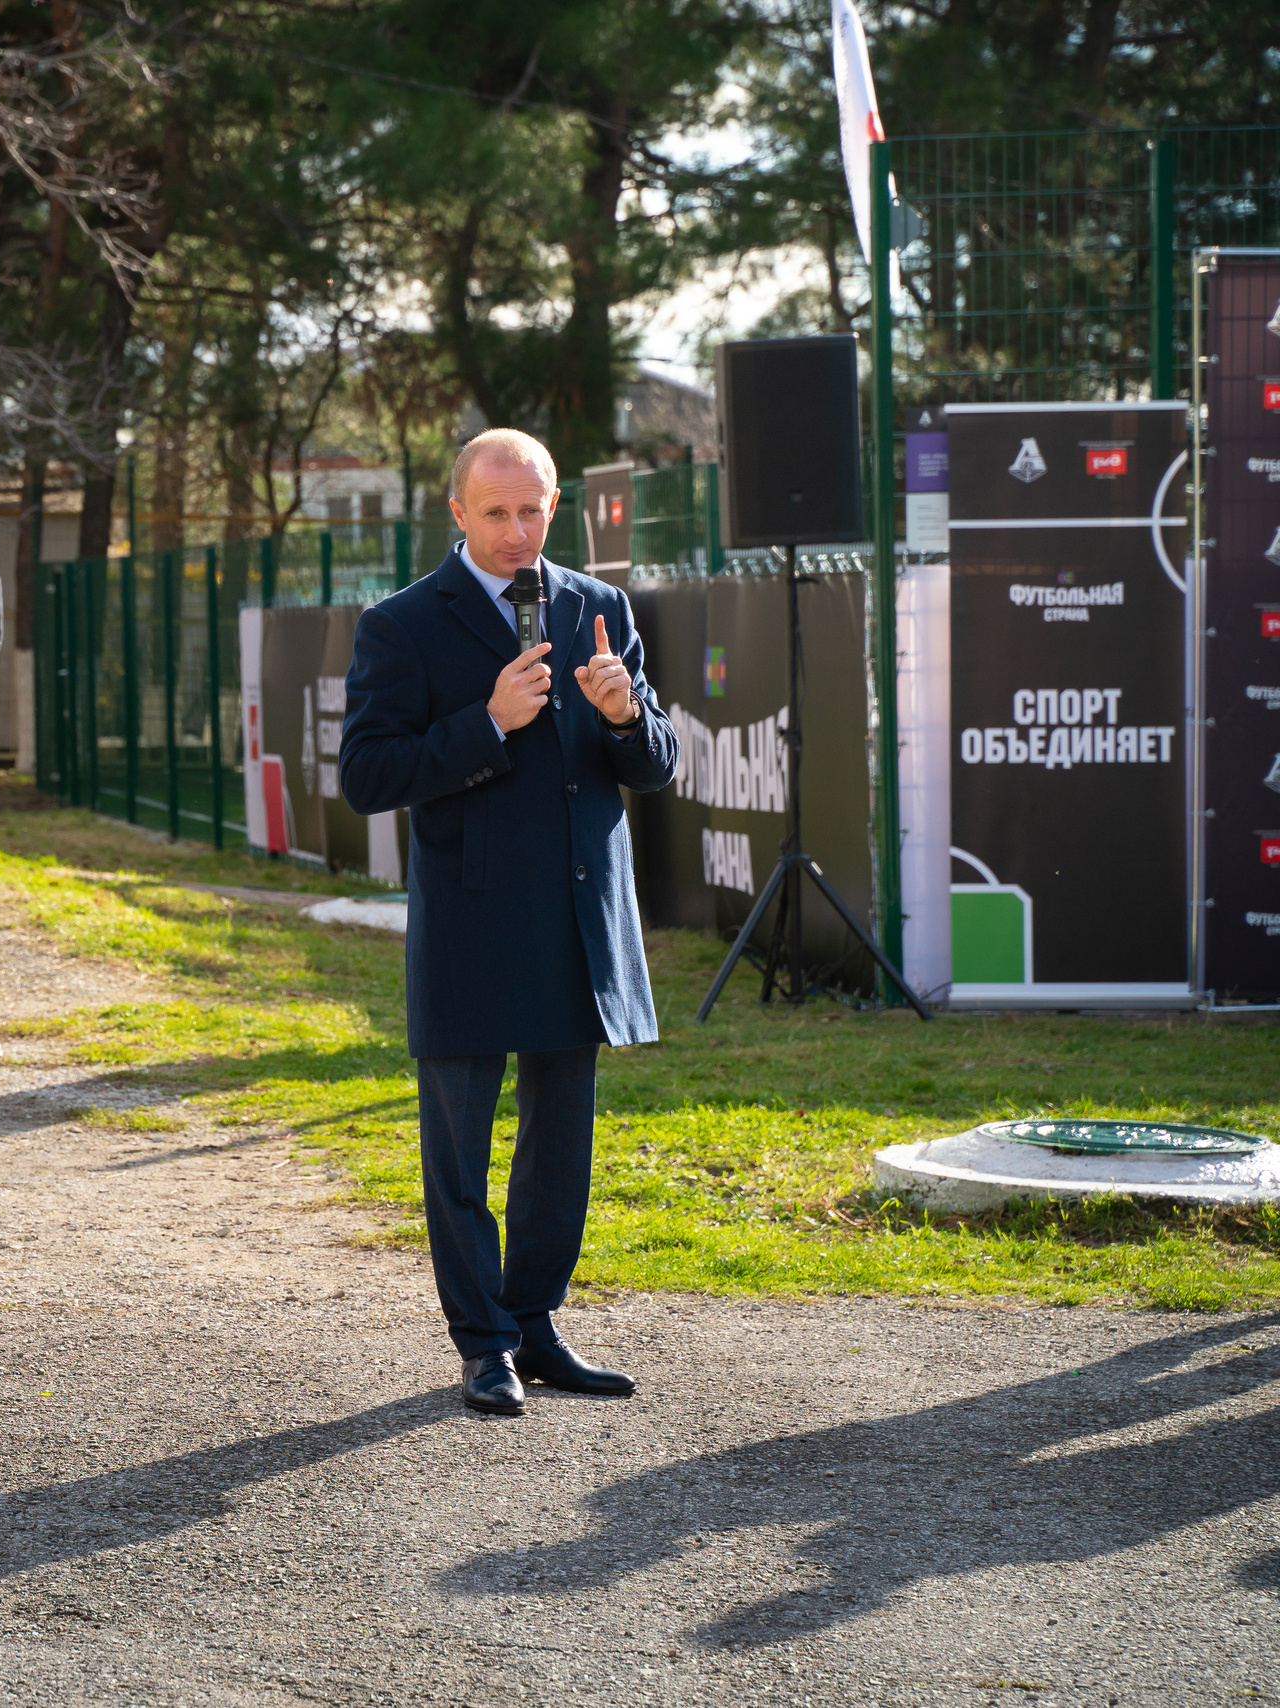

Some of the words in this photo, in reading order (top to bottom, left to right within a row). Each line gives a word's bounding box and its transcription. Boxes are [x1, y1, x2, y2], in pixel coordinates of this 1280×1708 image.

[1009, 582, 1124, 606] ФУТБОЛЬНАЯ
[1043, 607, 1090, 622] СТРАНА
[1013, 688, 1122, 726] СПОРТ
[961, 726, 1176, 770] ОБЪЕДИНЯЕТ
